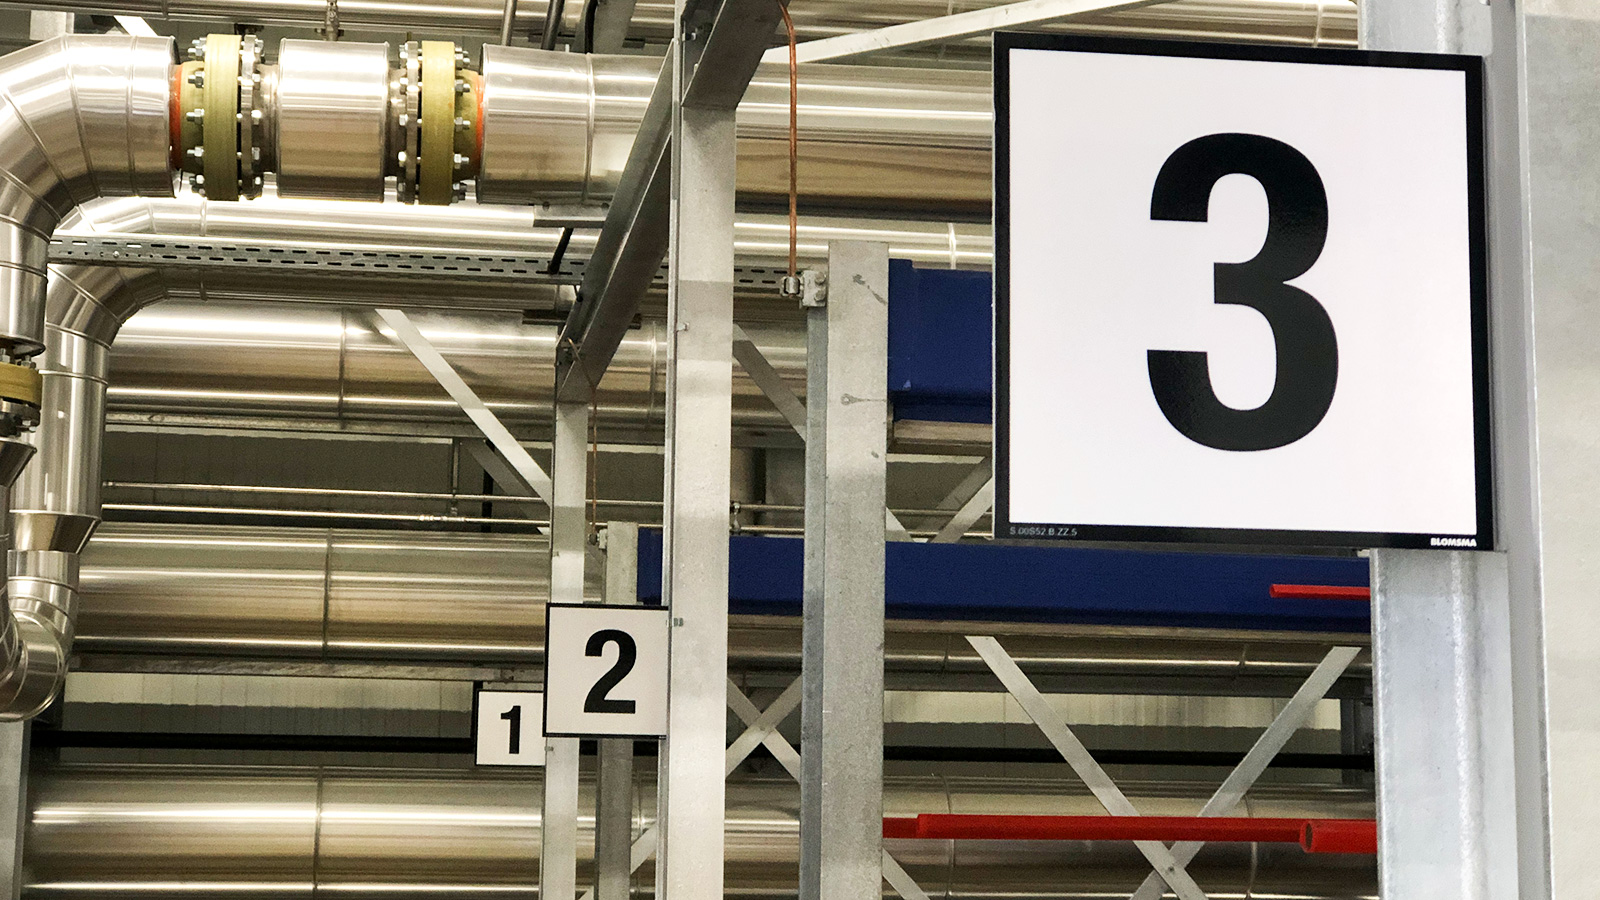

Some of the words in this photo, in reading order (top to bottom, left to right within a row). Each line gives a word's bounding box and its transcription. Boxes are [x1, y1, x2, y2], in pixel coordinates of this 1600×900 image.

[1147, 132, 1338, 451] 3
[1430, 537, 1477, 547] BLOMSMA
[584, 628, 636, 714] 2
[501, 705, 522, 754] 1
